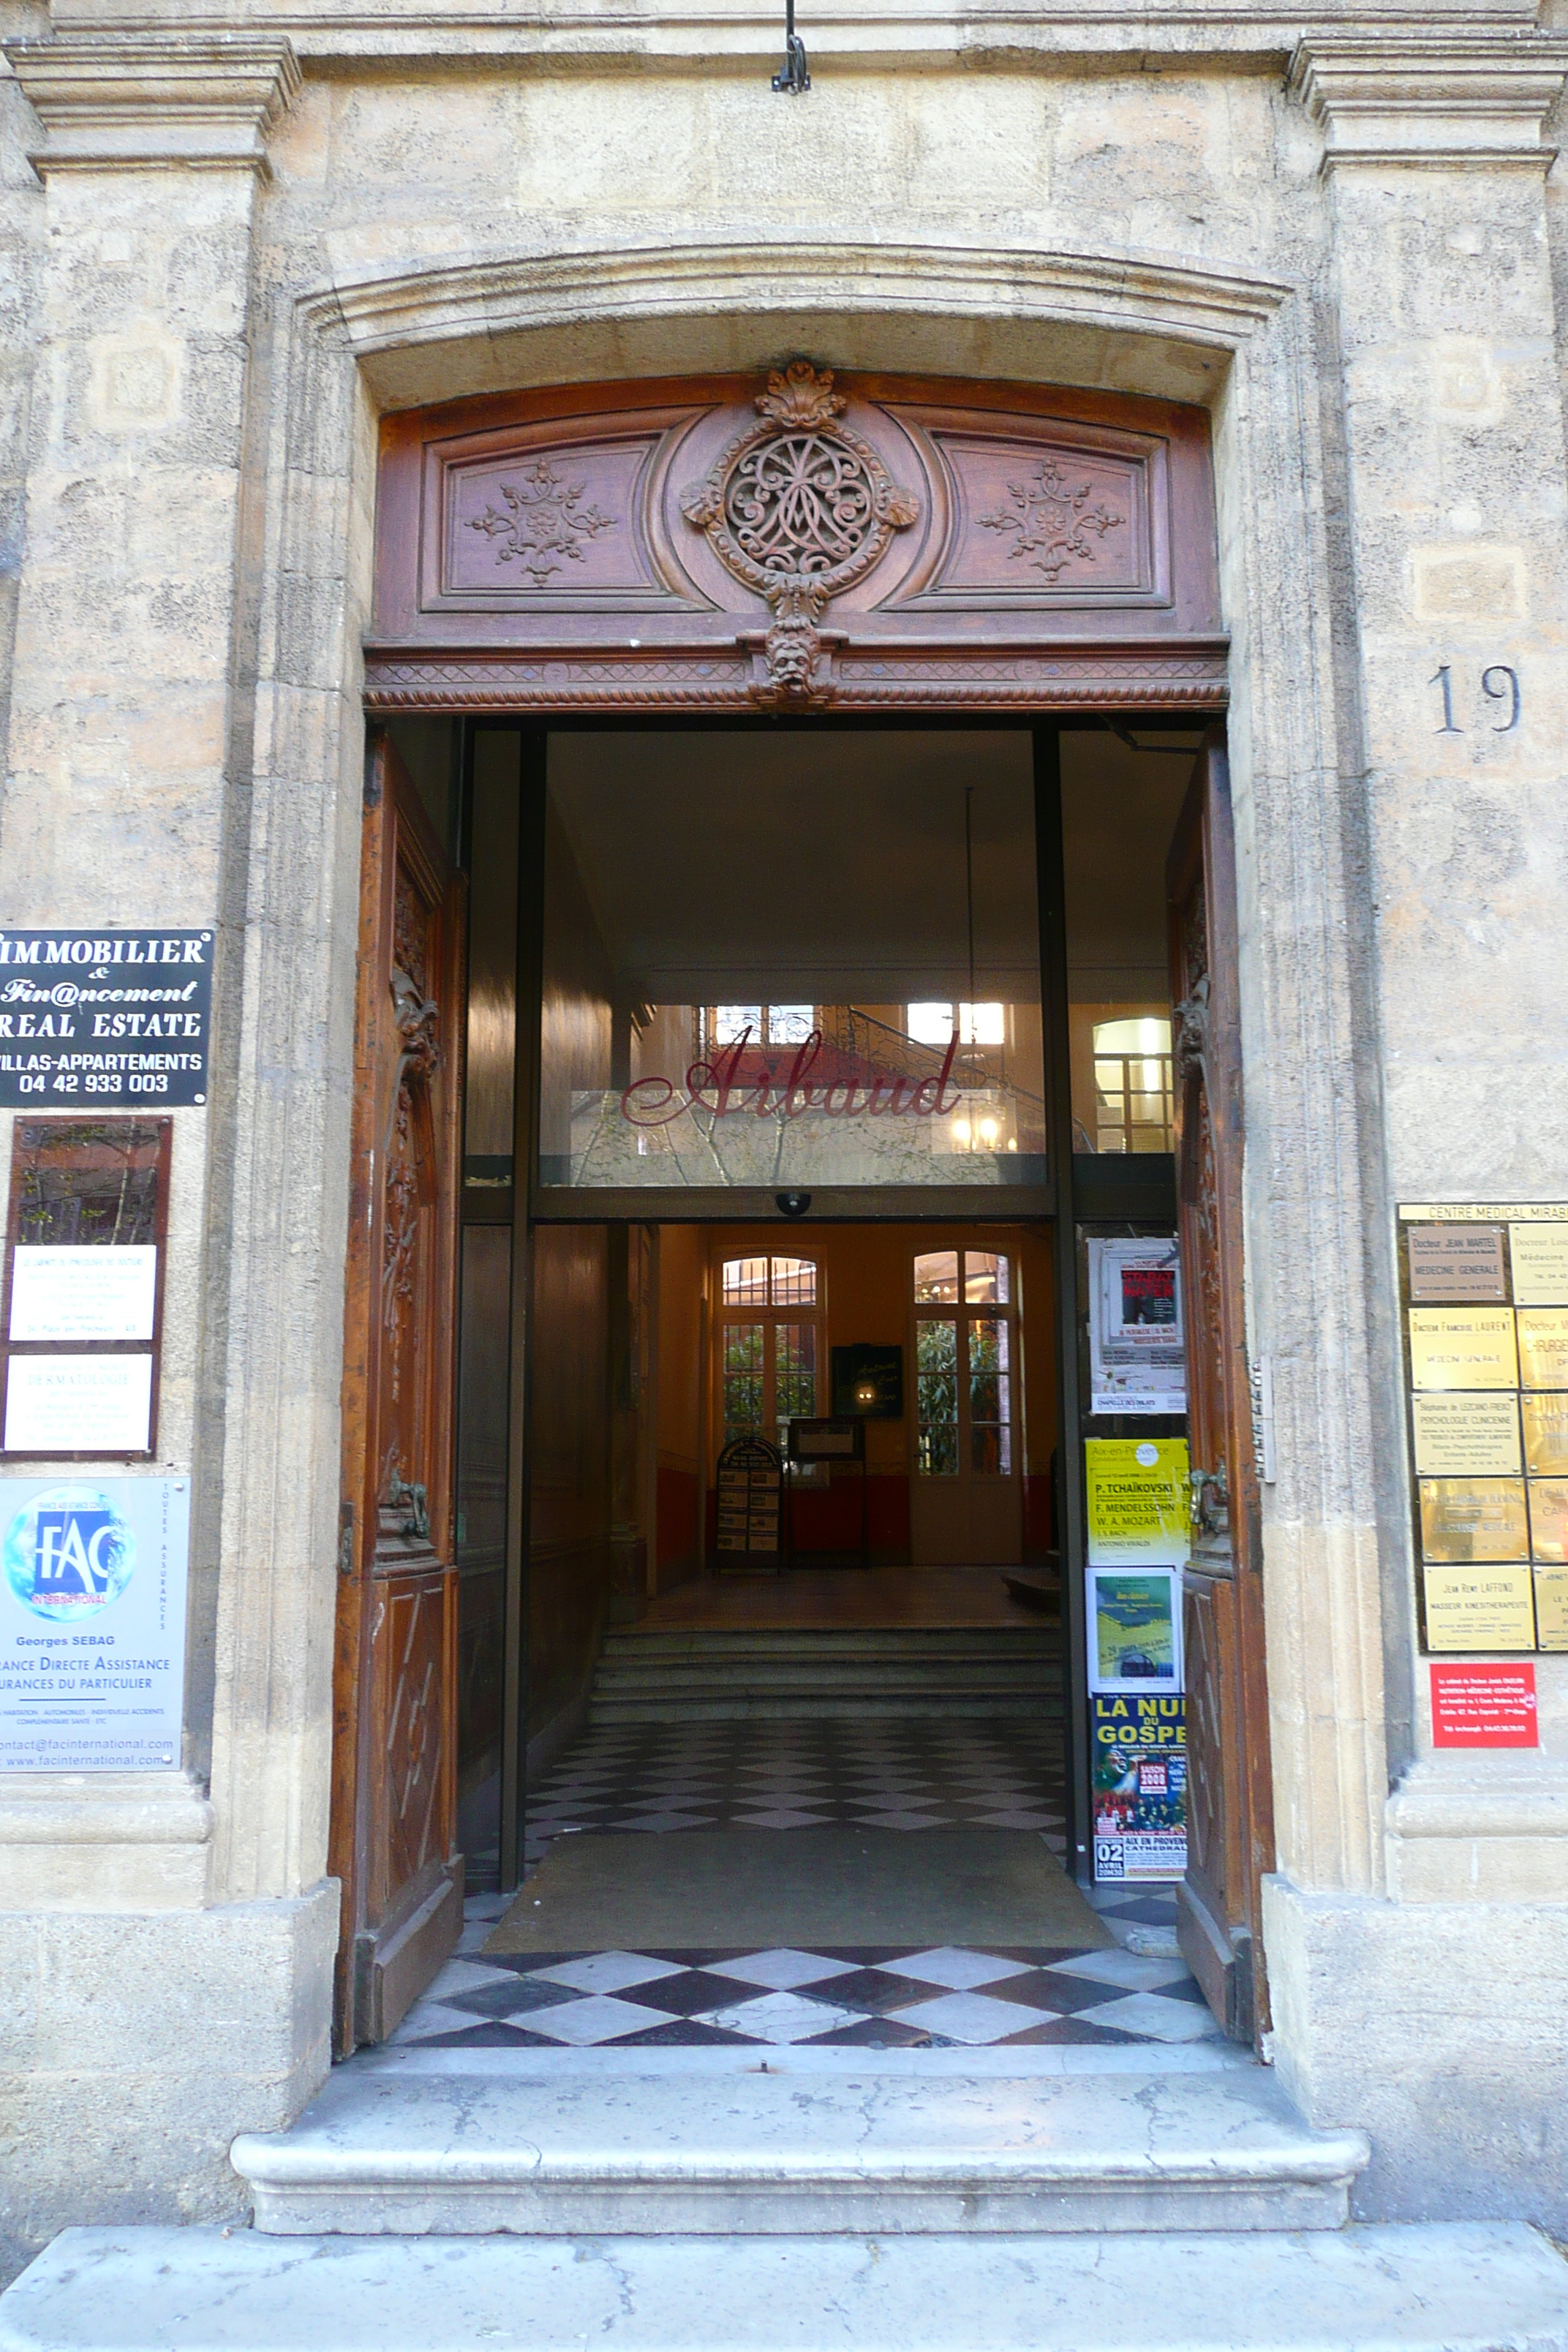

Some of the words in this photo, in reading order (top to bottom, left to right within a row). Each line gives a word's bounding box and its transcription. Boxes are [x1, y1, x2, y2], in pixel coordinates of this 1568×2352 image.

[1428, 666, 1520, 734] 19
[0, 940, 206, 964] IMMOBILIER
[88, 966, 110, 979] &
[0, 978, 197, 1008] Fin@ncement
[0, 1014, 76, 1038] REAL
[91, 1013, 201, 1037] ESTATE
[0, 1053, 203, 1071] ILLAS-APPARTEMENTS
[19, 1074, 45, 1093] 04
[53, 1074, 78, 1093] 42
[85, 1074, 122, 1092] 933
[129, 1074, 168, 1092] 003
[1429, 1207, 1472, 1218] CENTRE
[1476, 1207, 1526, 1218] MEDICAL
[1531, 1207, 1568, 1218] MIRAB
[1412, 1238, 1441, 1248] Docteur
[1446, 1239, 1463, 1248] JEAN
[1415, 1265, 1455, 1275] MEDECINE
[1458, 1265, 1499, 1275] GENERALE
[1475, 1322, 1510, 1331] LAURENT
[28, 1373, 130, 1385] DERMATOLOGIE
[1420, 1416, 1469, 1424] PSYCHOLOGUE
[1471, 1416, 1512, 1424] CLINICIENNE
[1093, 1446, 1169, 1455] Aix-en-Provence
[1096, 1485, 1105, 1493] P.
[1107, 1482, 1173, 1493] TCHAÏKOVSKI
[1096, 1504, 1104, 1512] F.
[1106, 1503, 1175, 1512] MENDELSSOHN
[1097, 1517, 1109, 1526] W.
[1112, 1517, 1120, 1526] A.
[1122, 1517, 1161, 1526] MOZART
[35, 1518, 113, 1593] FAC
[31, 1594, 107, 1605] INTERNATIONAL
[1465, 1601, 1529, 1609] KINESITHERAPEUTE
[16, 1636, 68, 1648] Georges
[72, 1636, 116, 1646] SEBAG
[59, 1679, 75, 1689] DU
[80, 1678, 152, 1689] PARTICULIER
[1096, 1699, 1129, 1717] LA
[1143, 1717, 1159, 1725] DU
[7, 1754, 163, 1766] www.facinternational.com
[1141, 1765, 1166, 1774] SAISON
[1141, 1774, 1166, 1785] 2008
[1098, 1844, 1123, 1861] 02
